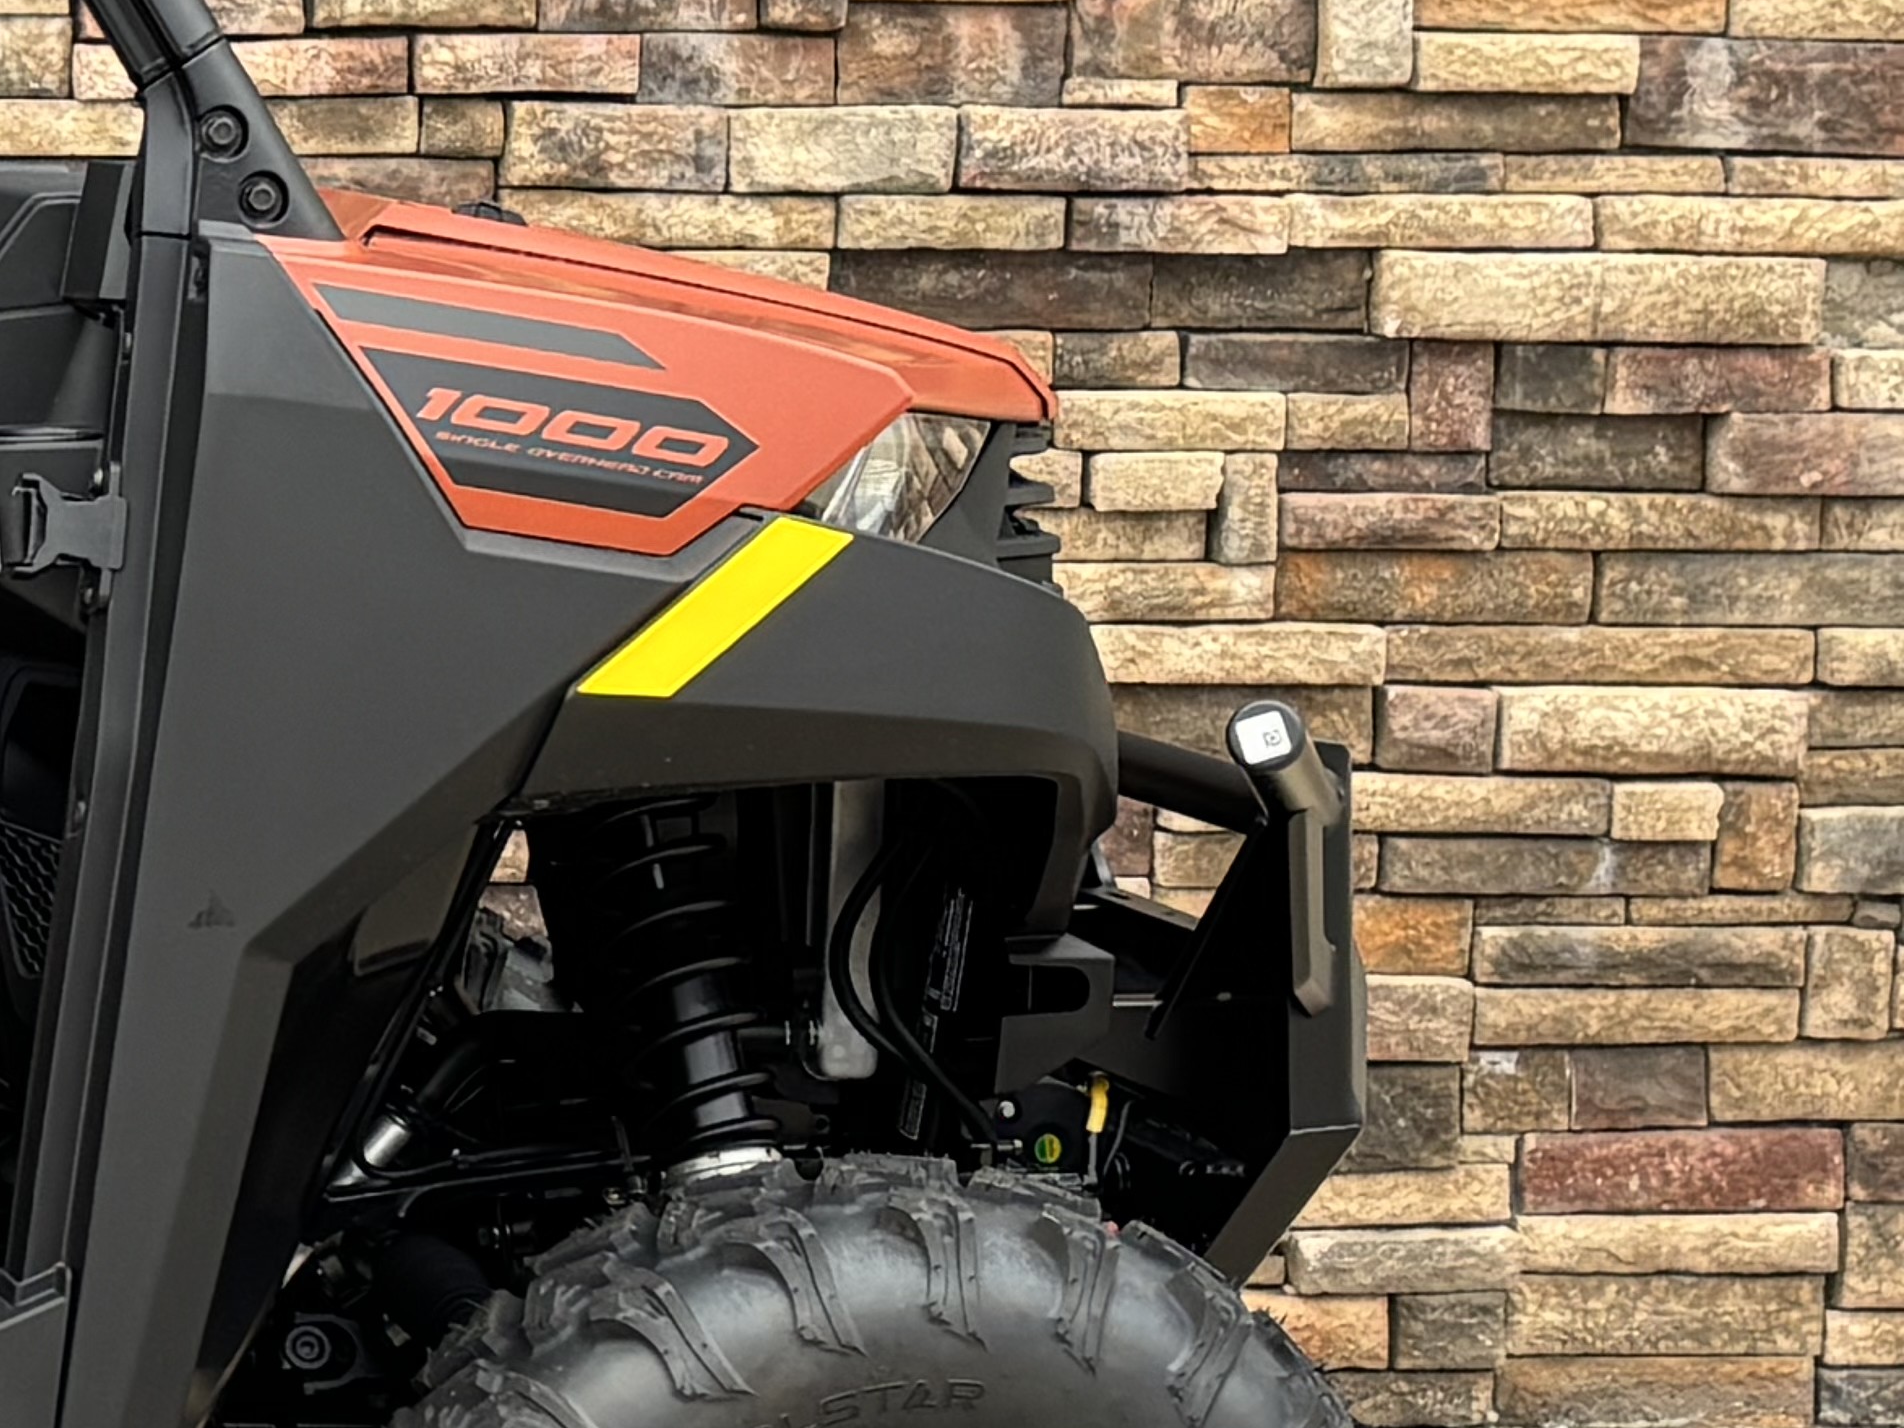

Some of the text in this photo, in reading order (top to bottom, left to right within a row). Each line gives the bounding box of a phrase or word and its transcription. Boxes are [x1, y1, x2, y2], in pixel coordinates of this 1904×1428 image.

[416, 387, 729, 468] 1000
[435, 430, 521, 454] SINGLE
[527, 447, 650, 476] OVERHEAD
